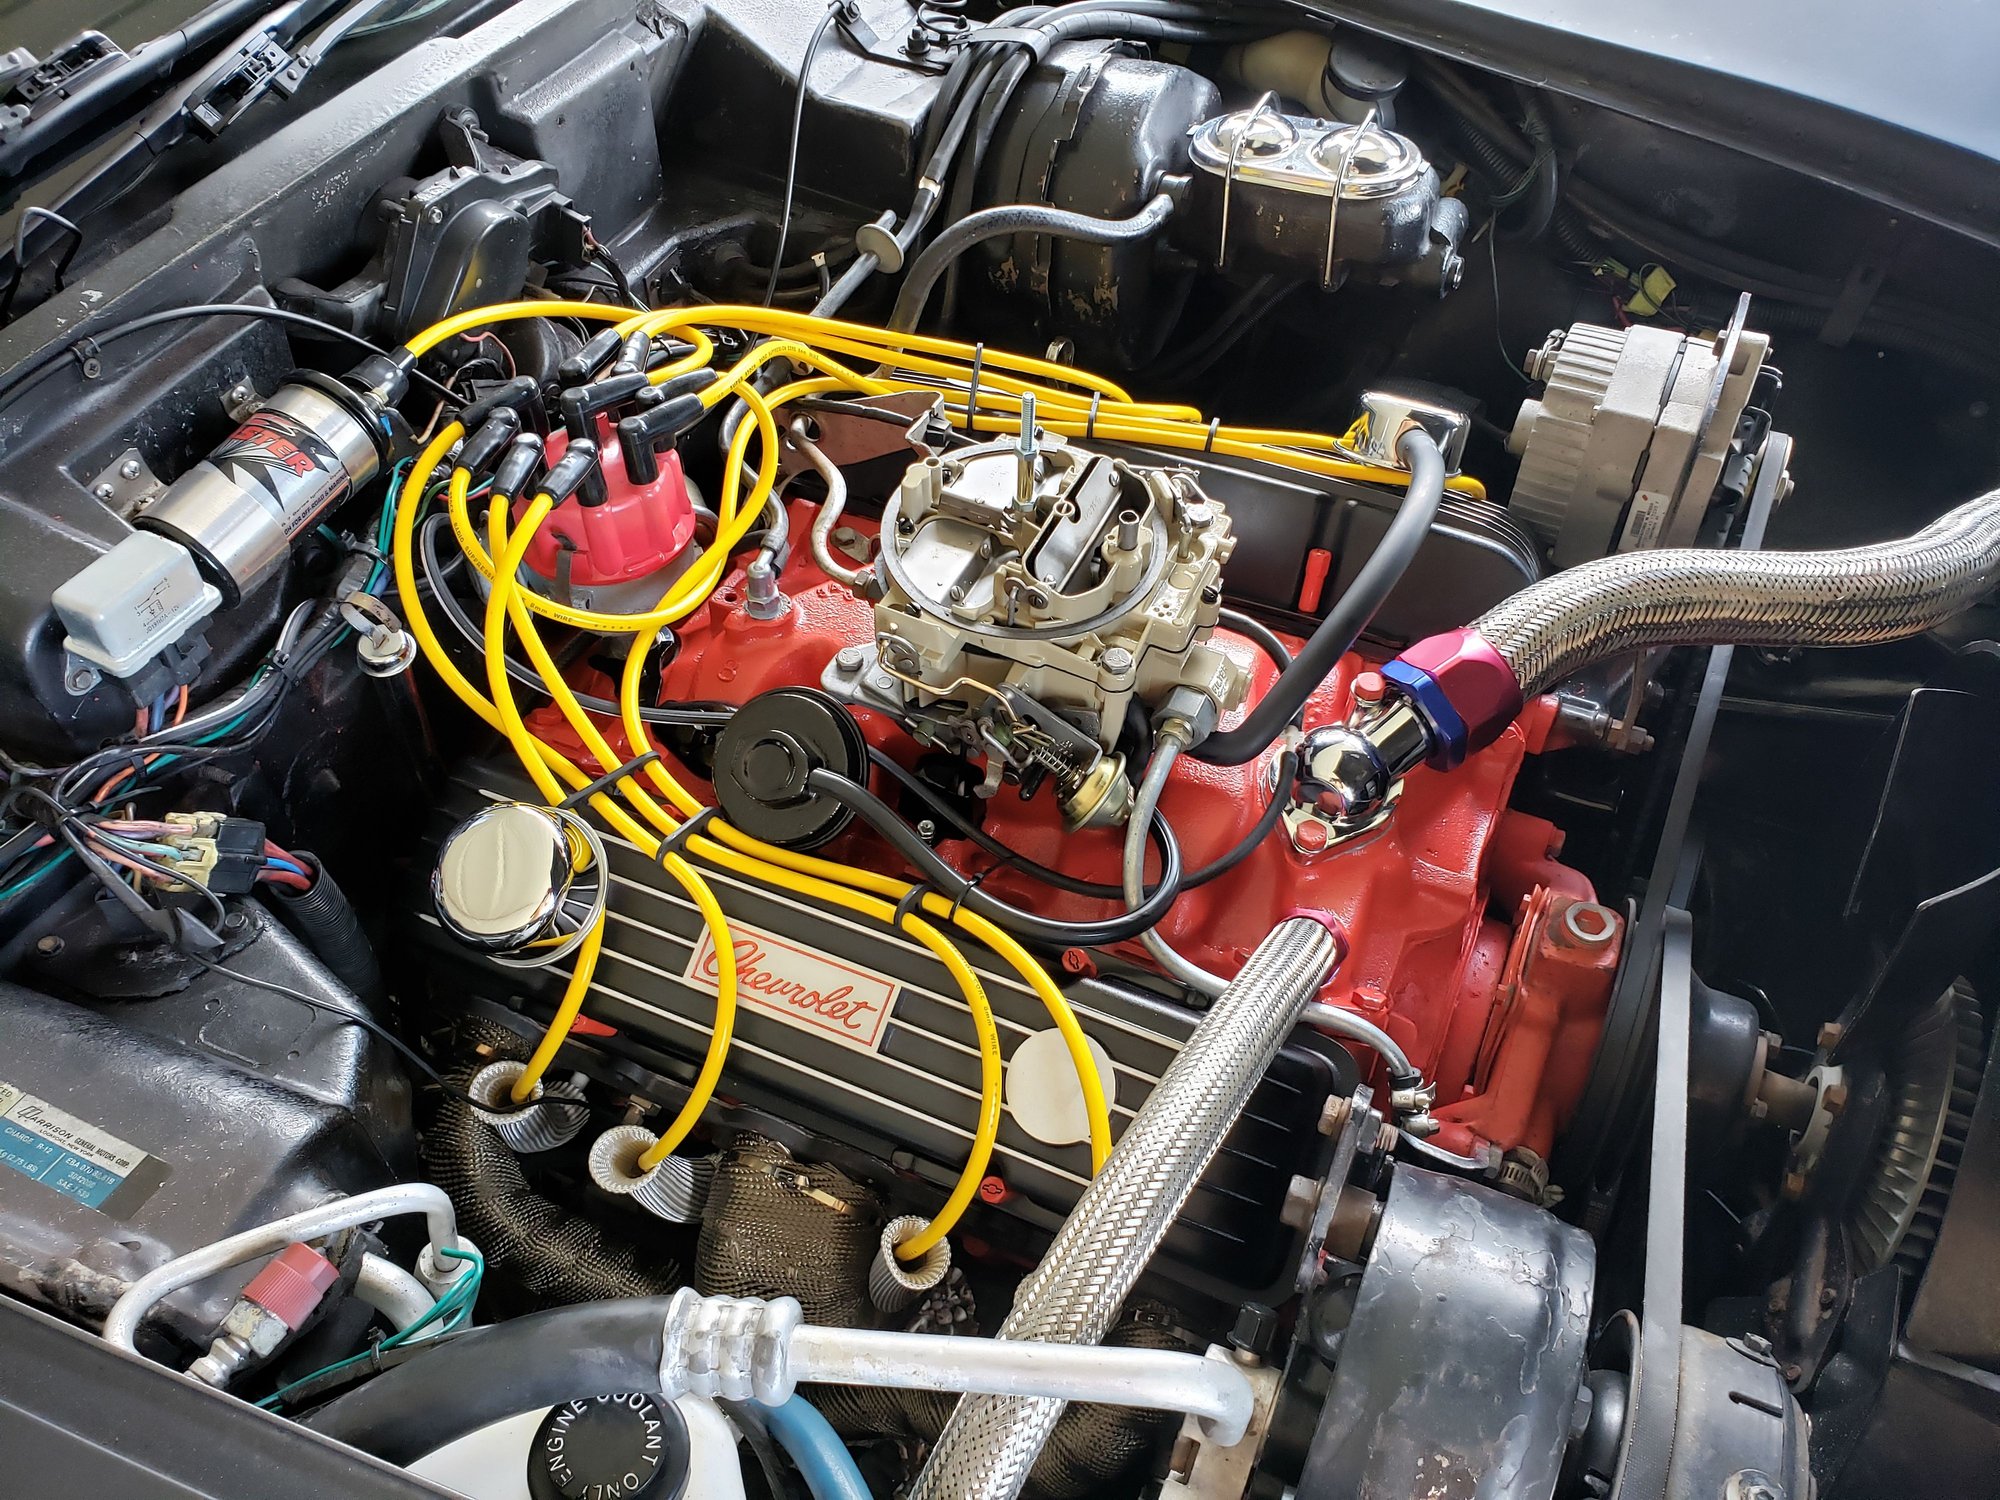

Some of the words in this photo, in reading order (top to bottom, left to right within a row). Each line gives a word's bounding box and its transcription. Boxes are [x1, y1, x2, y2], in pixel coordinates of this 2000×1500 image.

[703, 940, 878, 1029] Chevrolet
[4, 1127, 35, 1145] CHARGE
[36, 1143, 53, 1155] R-12
[65, 1157, 79, 1168] EBA
[95, 1148, 117, 1162] MOTORS
[56, 1178, 71, 1190] SAE
[546, 1399, 588, 1488] ENGINE
